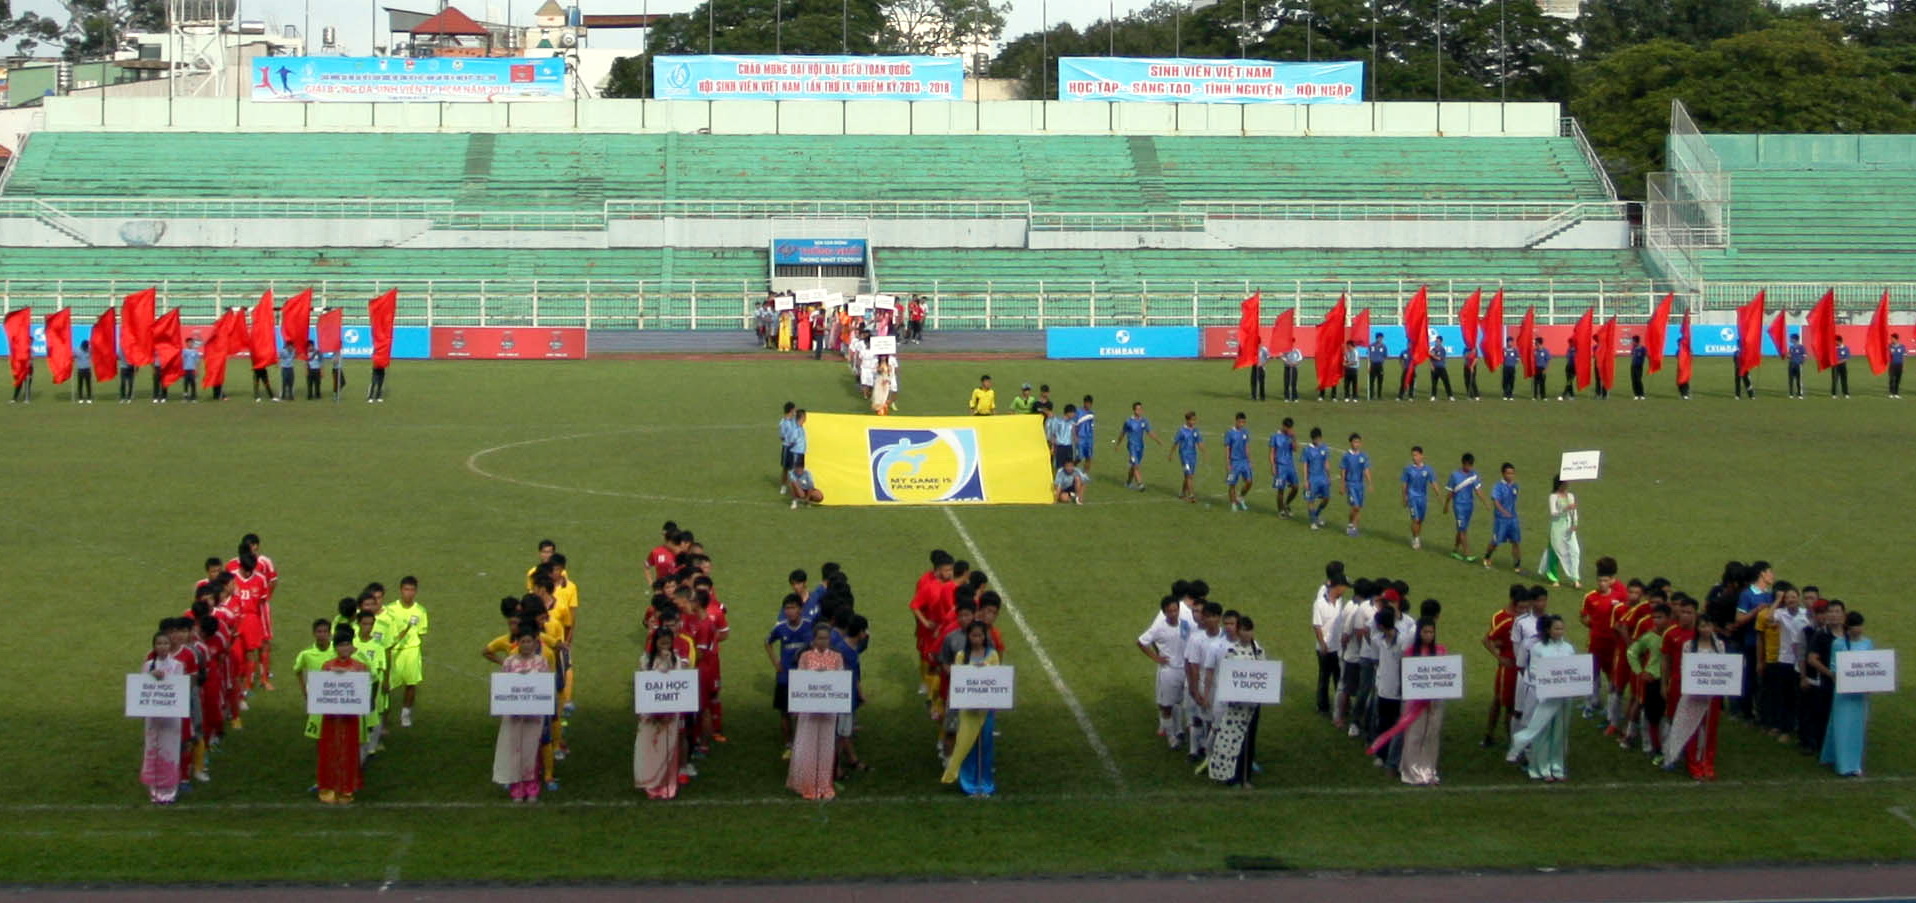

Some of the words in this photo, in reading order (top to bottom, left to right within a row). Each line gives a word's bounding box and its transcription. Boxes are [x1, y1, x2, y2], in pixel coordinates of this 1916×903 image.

[1150, 65, 1179, 77] SINH
[1184, 65, 1211, 77] VIÊN
[1216, 65, 1242, 80] VIỆT
[1246, 67, 1272, 78] NAM
[716, 81, 736, 92] SINH
[739, 80, 758, 92] VIÊN
[1069, 82, 1093, 96] HỌC
[1167, 83, 1191, 96] TẠO
[1099, 347, 1147, 356] EXIMBANK
[1249, 671, 1268, 681] HỌC
[665, 681, 689, 691] HỌC
[1232, 680, 1239, 688] Y
[654, 692, 680, 702] RMIT
